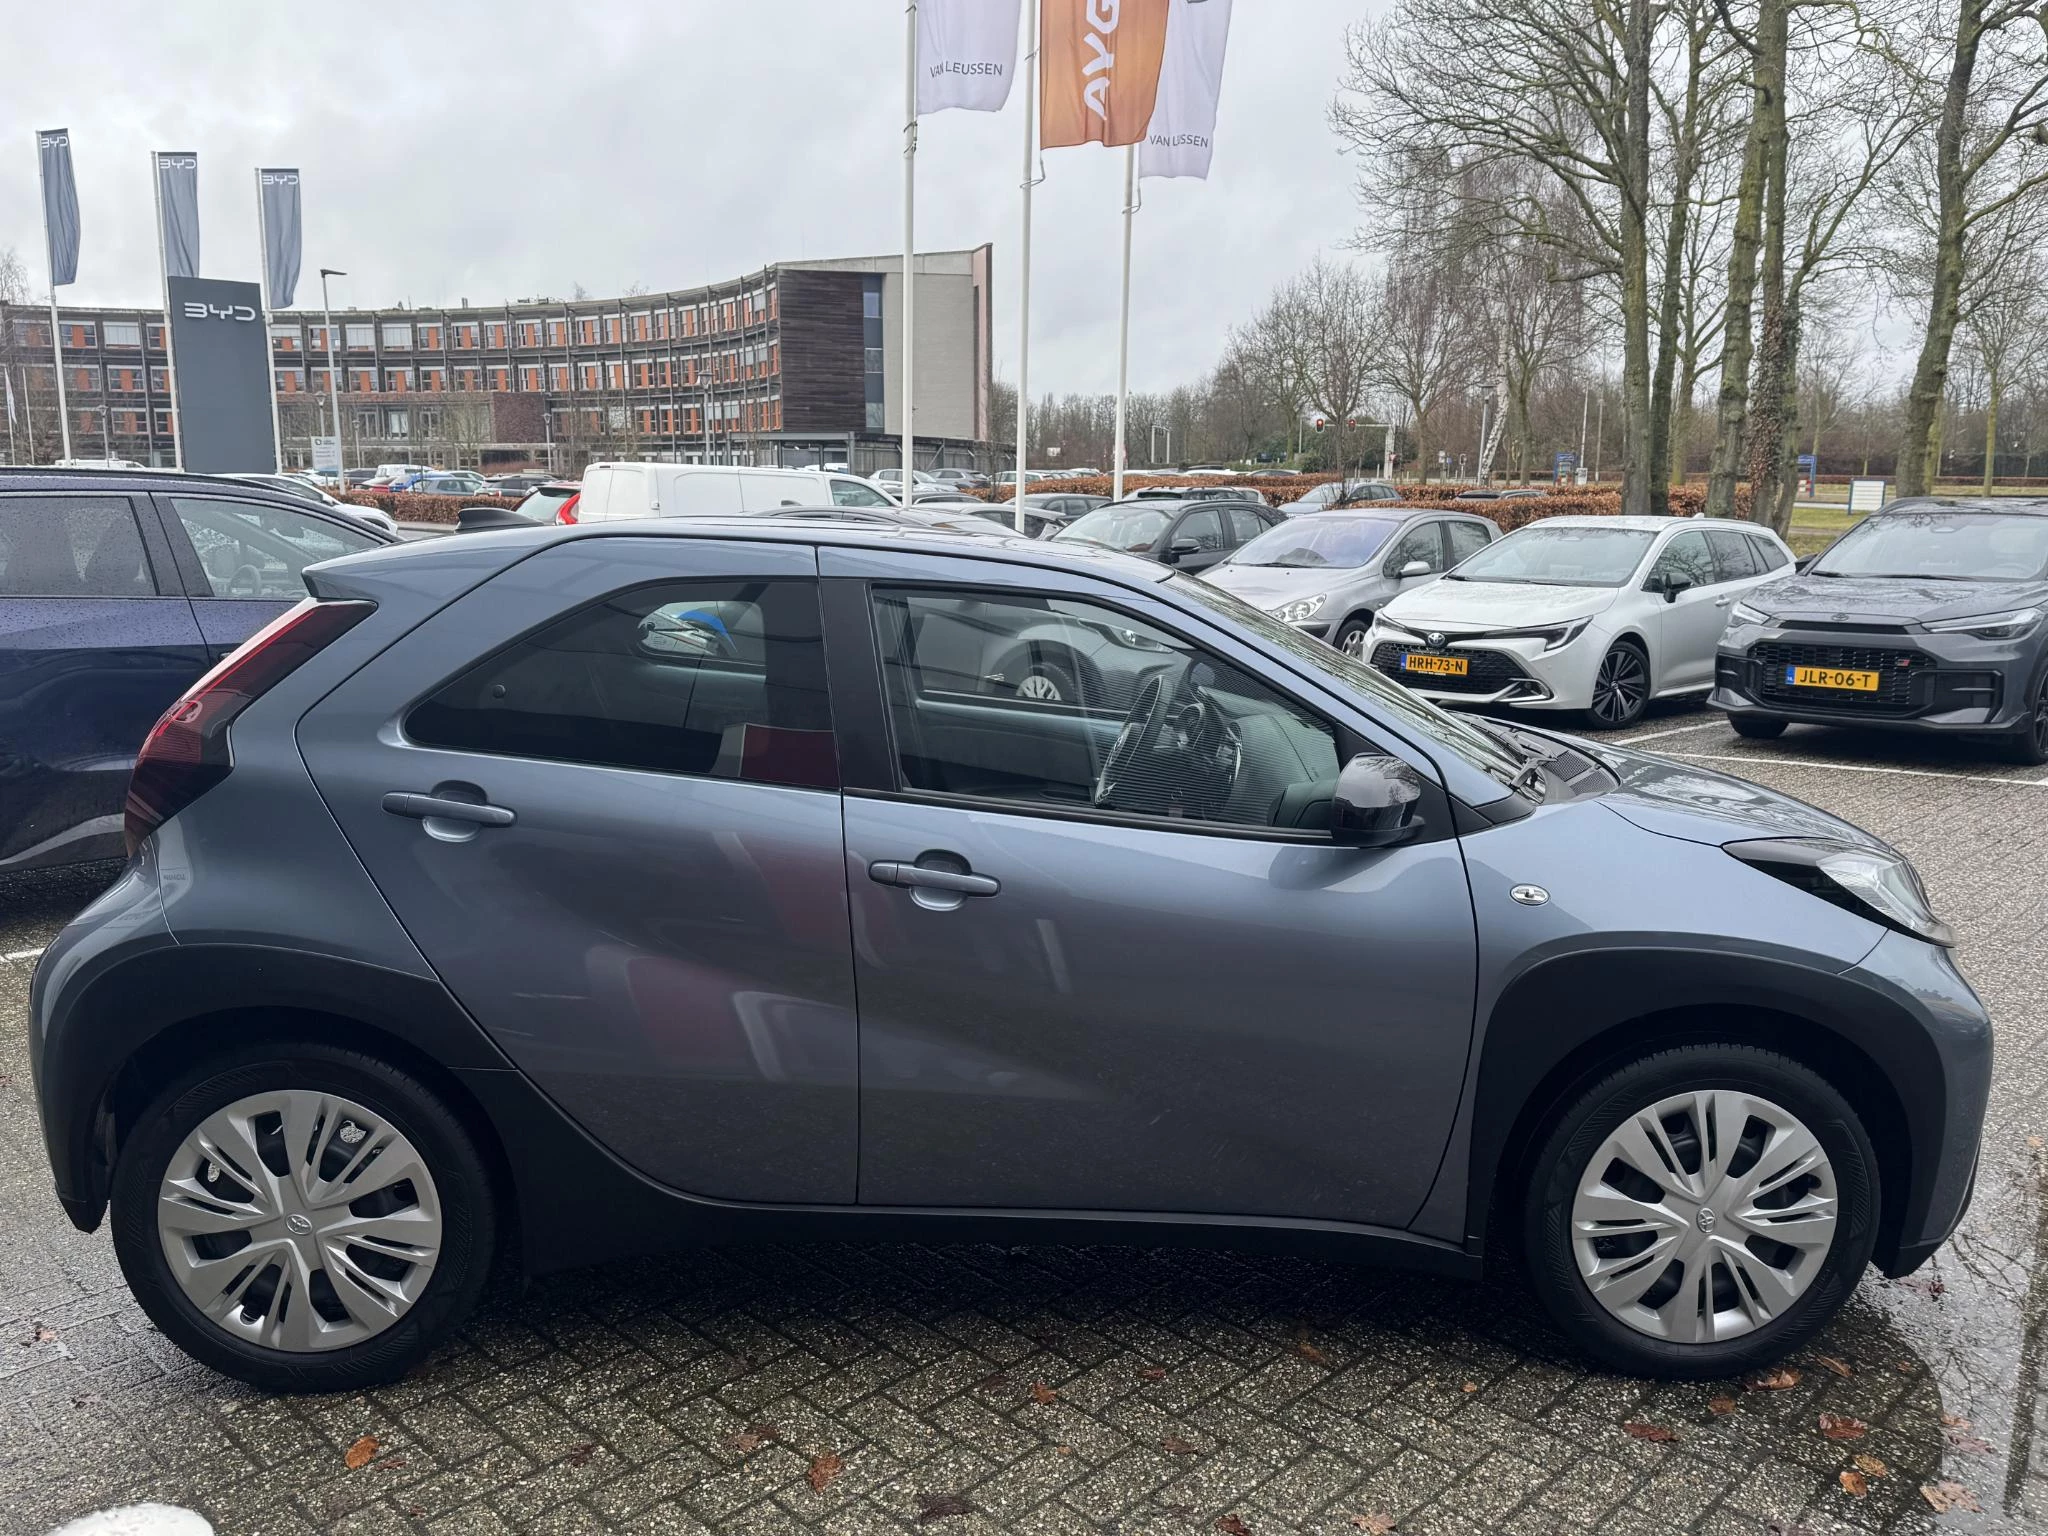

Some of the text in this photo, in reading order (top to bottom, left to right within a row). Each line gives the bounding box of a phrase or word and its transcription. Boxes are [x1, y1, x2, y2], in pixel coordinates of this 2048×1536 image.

[930, 60, 1003, 78] VAN LEUSSEN
[41, 136, 68, 149] BYD
[1150, 134, 1170, 147] VAN
[159, 158, 197, 170] BYD
[261, 174, 299, 186] BYD
[184, 302, 256, 322] BYD
[1409, 656, 1463, 673] HRH-73-N
[1800, 669, 1871, 688] JLR-06-T
